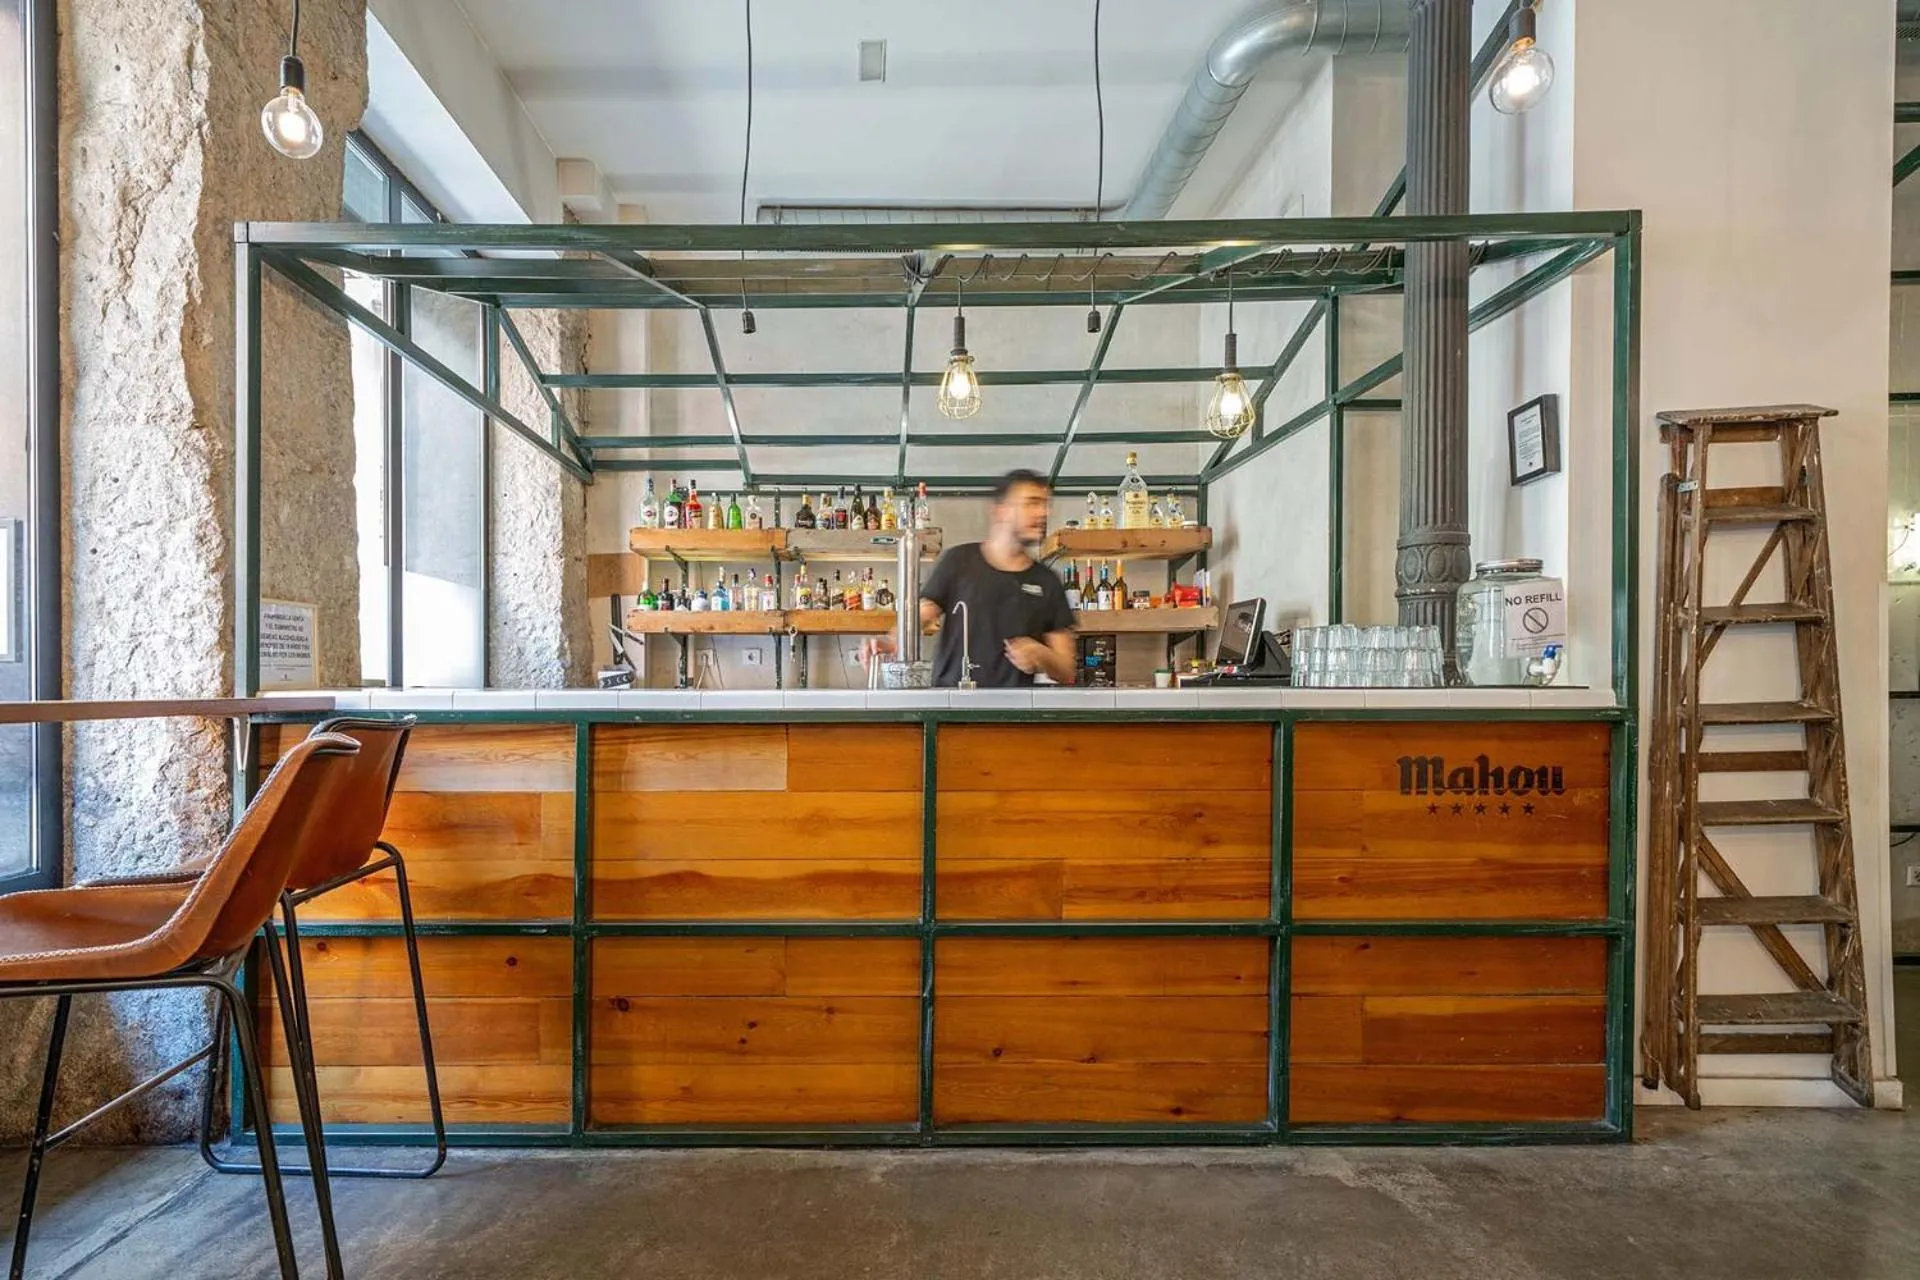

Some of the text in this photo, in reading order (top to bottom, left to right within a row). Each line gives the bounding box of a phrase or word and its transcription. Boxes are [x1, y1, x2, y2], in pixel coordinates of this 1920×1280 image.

[1505, 593, 1562, 607] NO REFILL
[1396, 753, 1567, 796] Mahou
